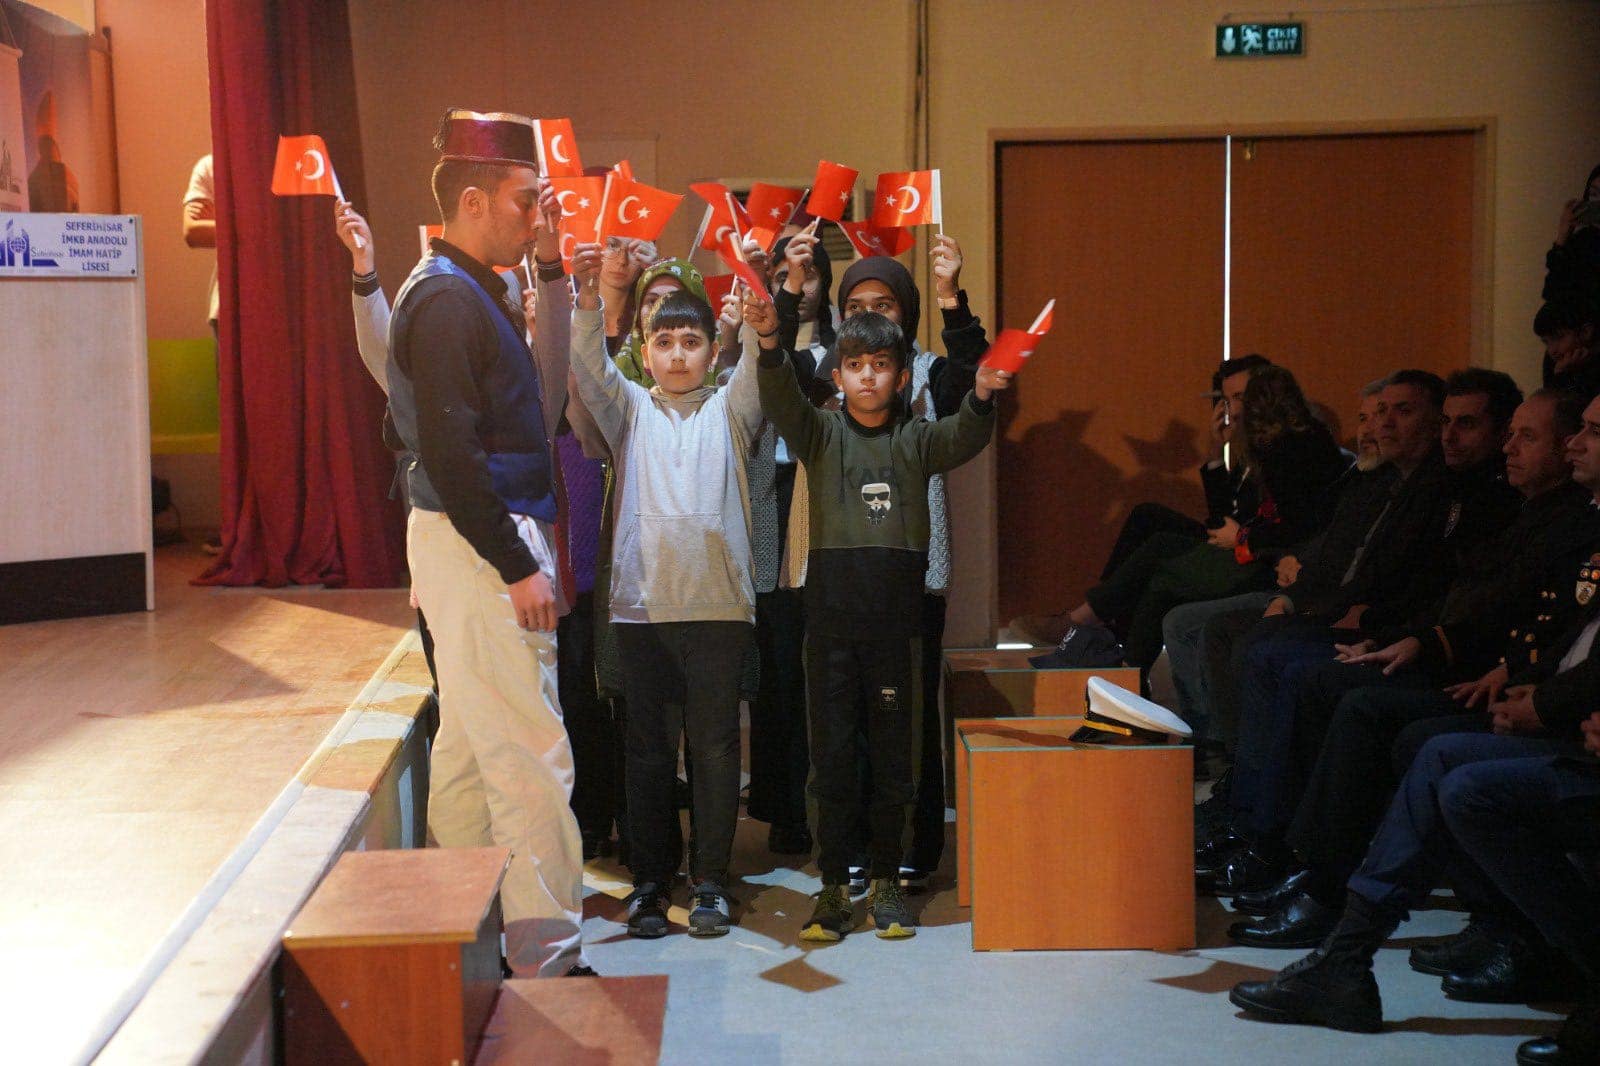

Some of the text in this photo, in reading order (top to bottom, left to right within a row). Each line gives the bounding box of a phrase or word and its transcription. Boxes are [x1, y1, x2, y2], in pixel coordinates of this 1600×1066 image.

[1267, 39, 1297, 52] EXIT
[88, 235, 128, 245] ANADOLU
[69, 245, 93, 258] İMAM
